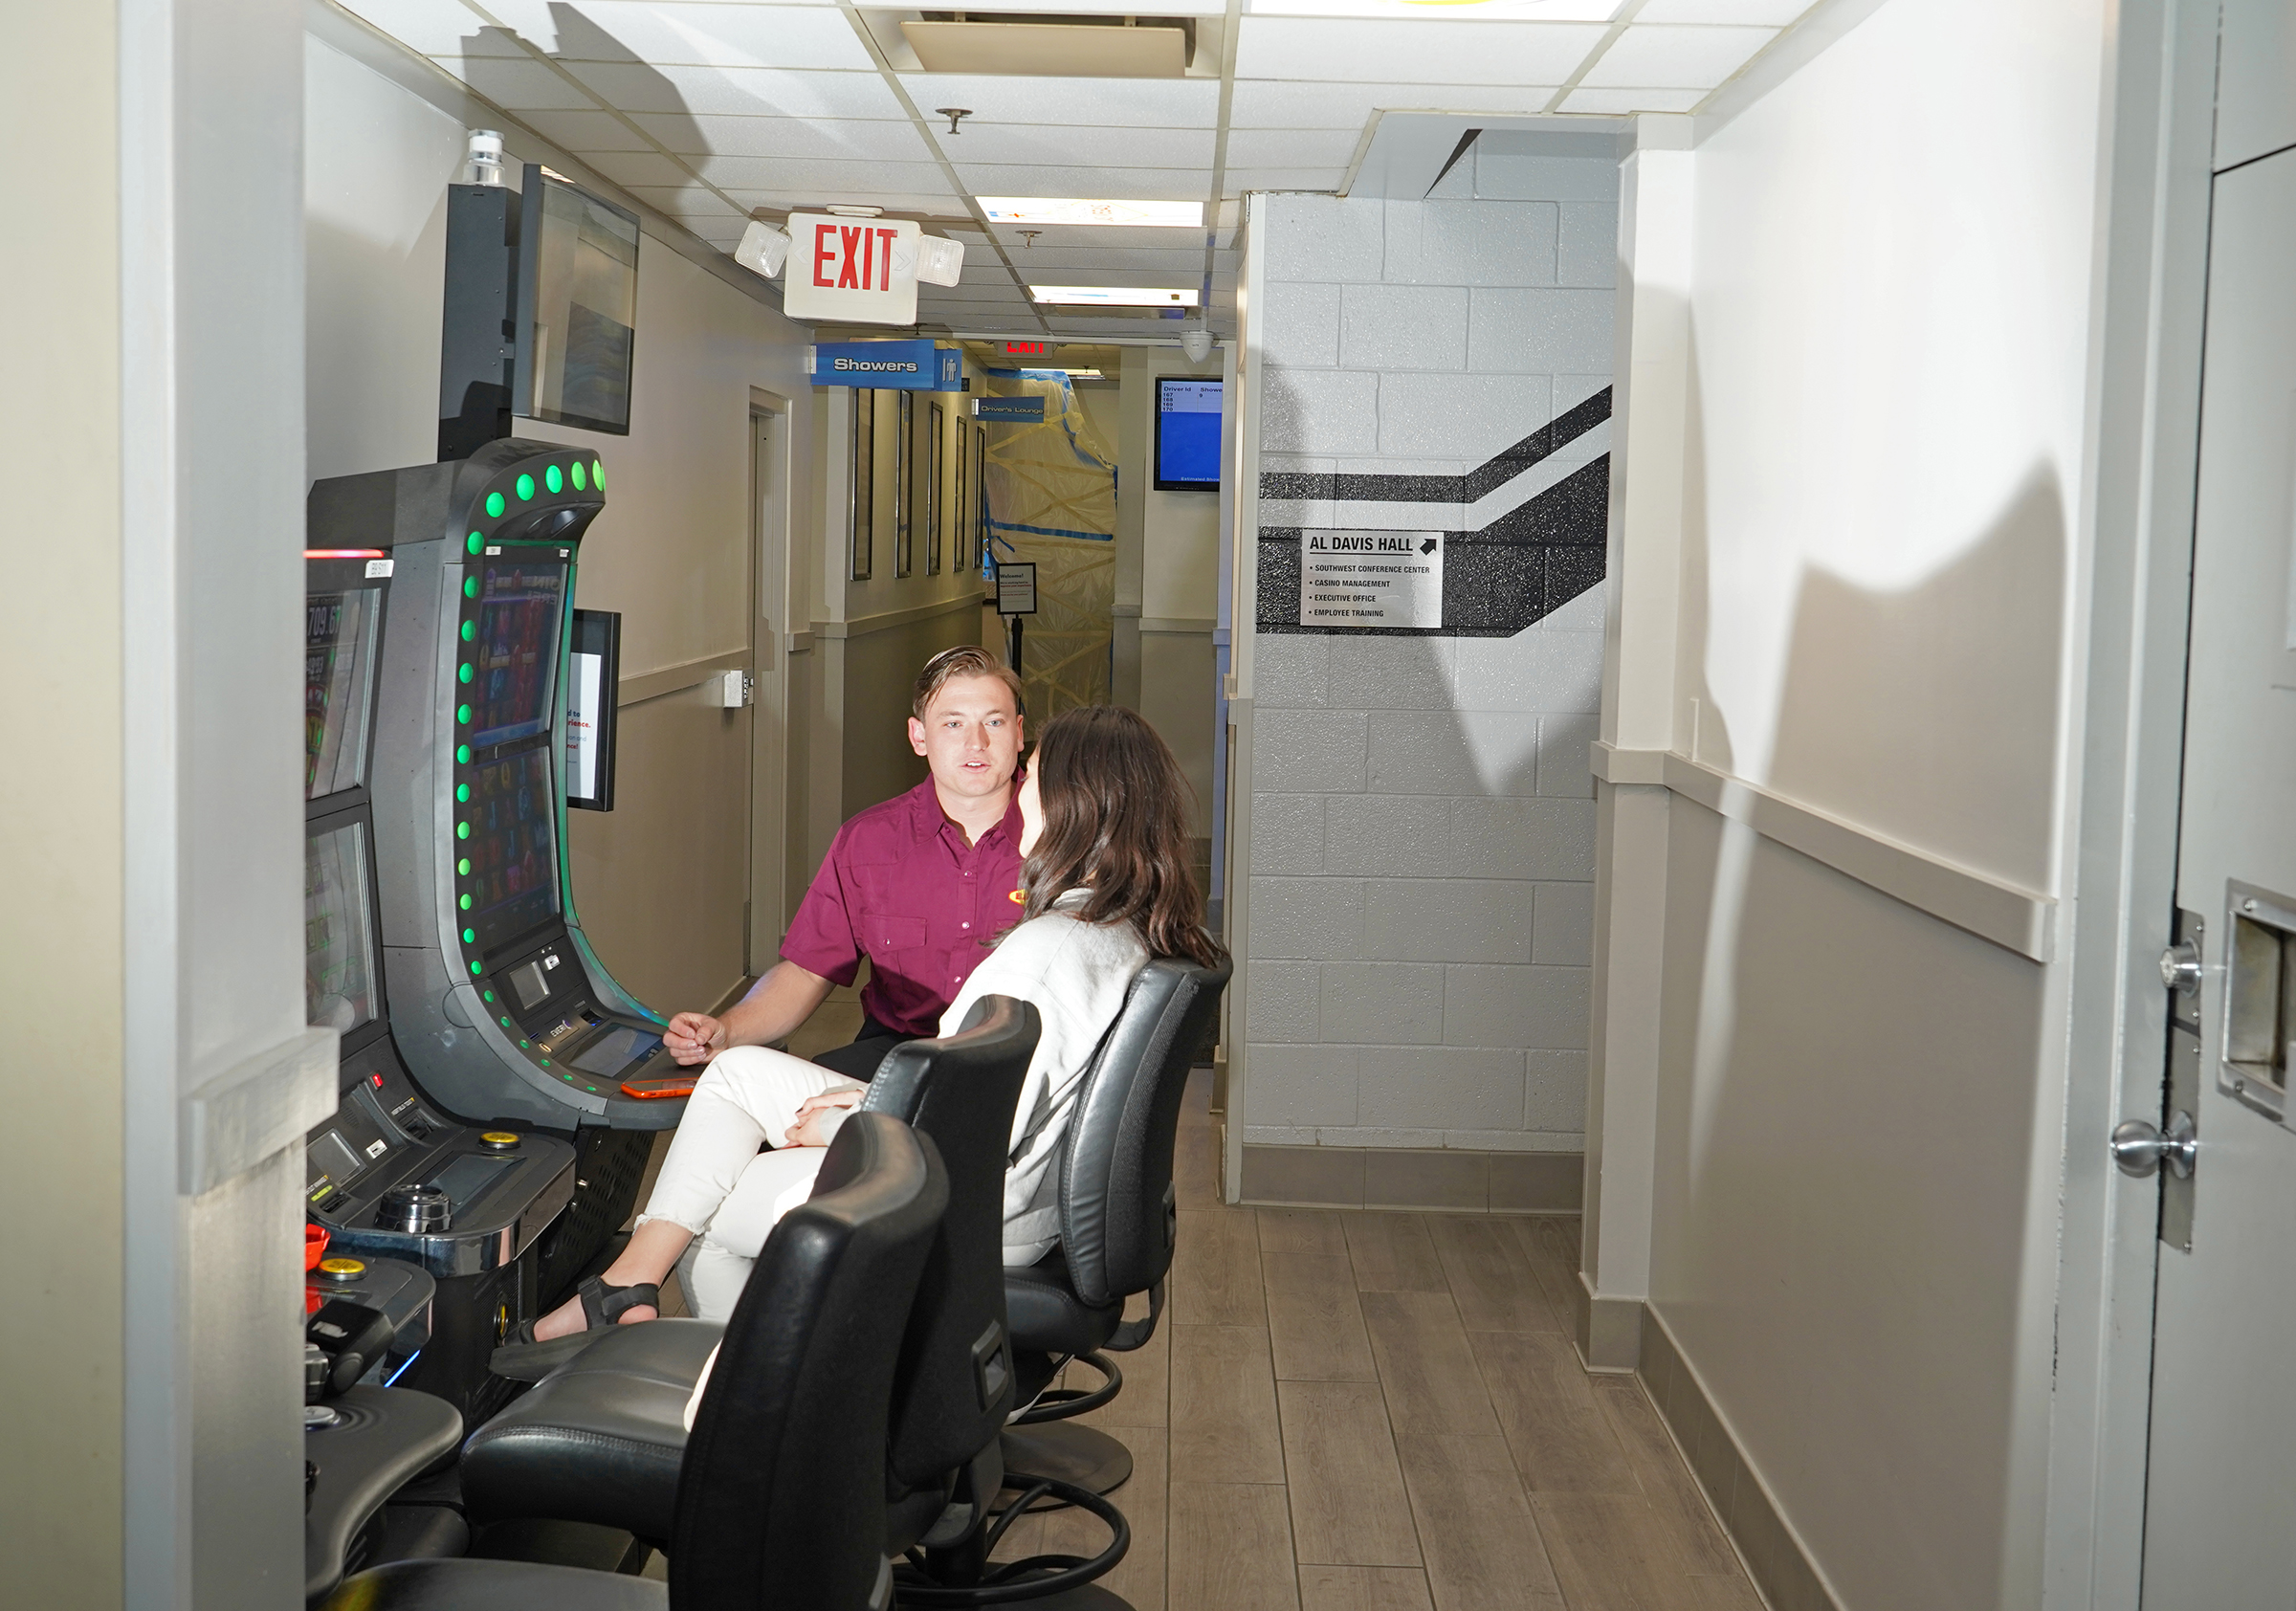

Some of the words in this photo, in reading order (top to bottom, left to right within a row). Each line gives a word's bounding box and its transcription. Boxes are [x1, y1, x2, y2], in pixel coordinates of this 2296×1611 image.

[813, 224, 898, 291] EXIT
[834, 357, 918, 372] Showers
[1310, 537, 1328, 550] AL
[1332, 537, 1374, 550] DAVIS
[1379, 538, 1413, 551] HALL
